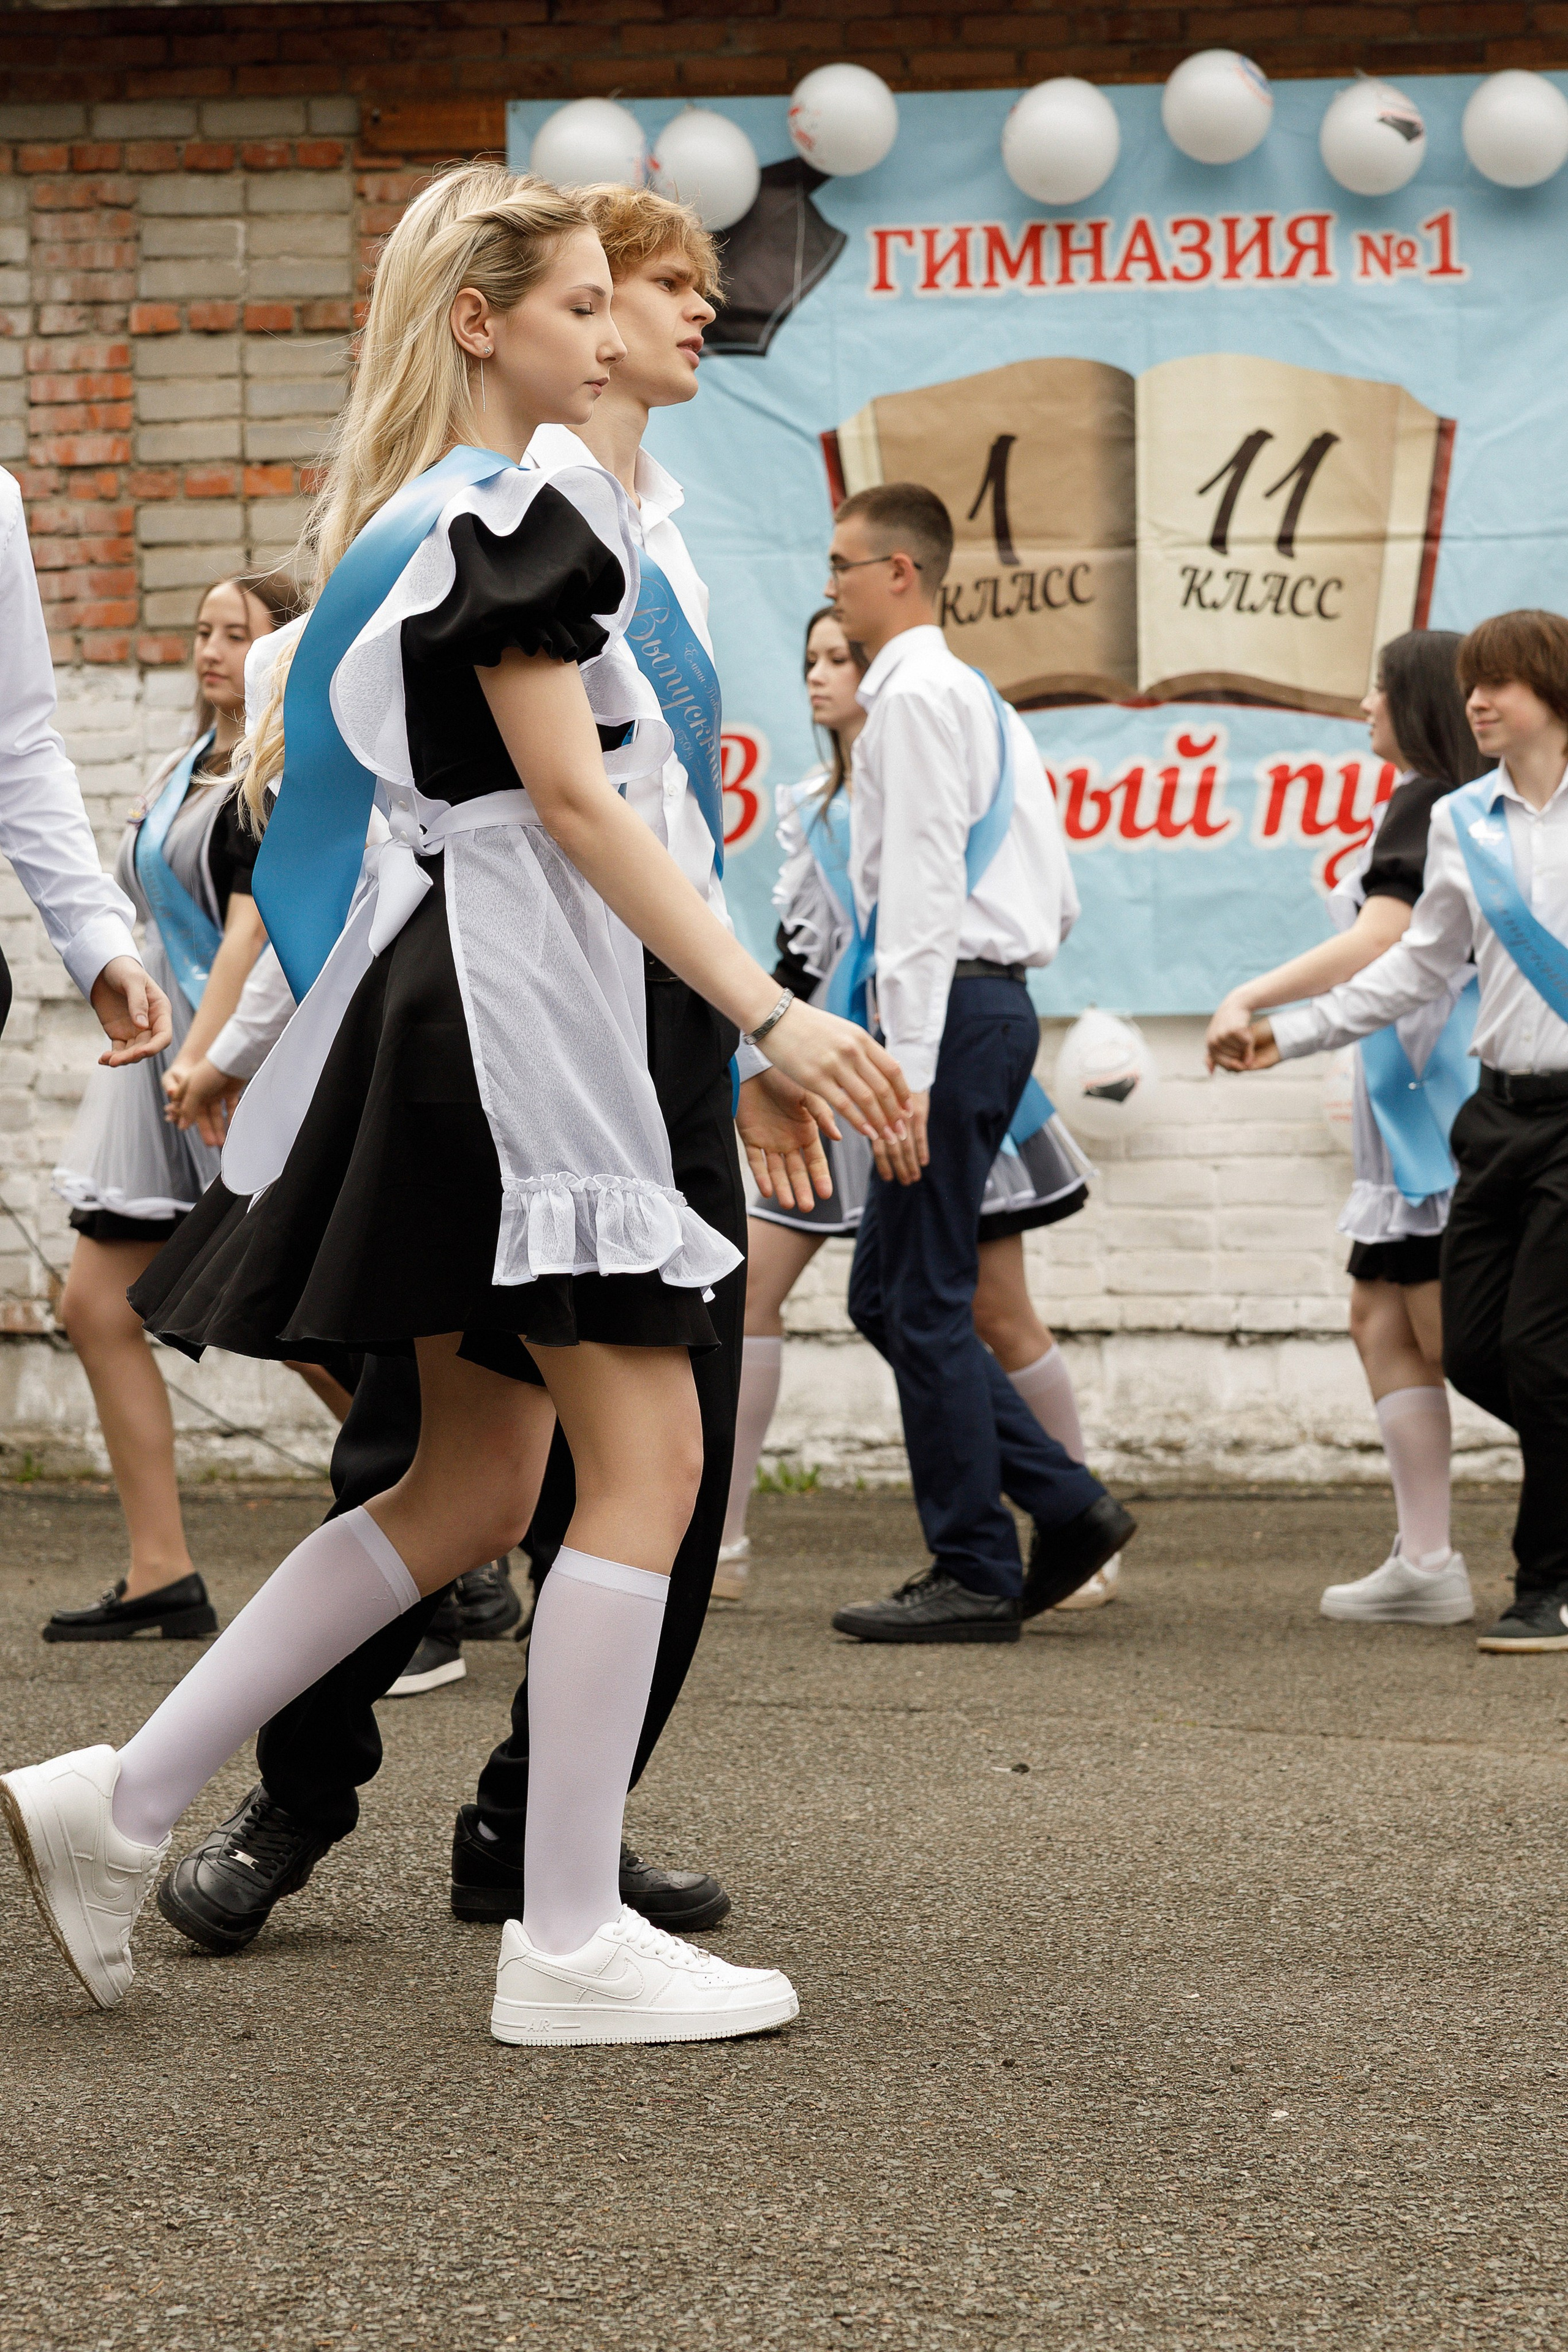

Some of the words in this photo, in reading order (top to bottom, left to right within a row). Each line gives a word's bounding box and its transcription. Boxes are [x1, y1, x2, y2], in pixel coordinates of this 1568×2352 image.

[872, 214, 1332, 292] ГИМНАЗИЯ
[1358, 213, 1464, 277] №1
[968, 433, 1020, 567] 1
[1196, 428, 1341, 559] 11
[940, 562, 1095, 627] КЛАСС
[1180, 565, 1344, 621] КЛАСС
[1262, 760, 1399, 891] пу
[525, 2018, 551, 2032] AIR
